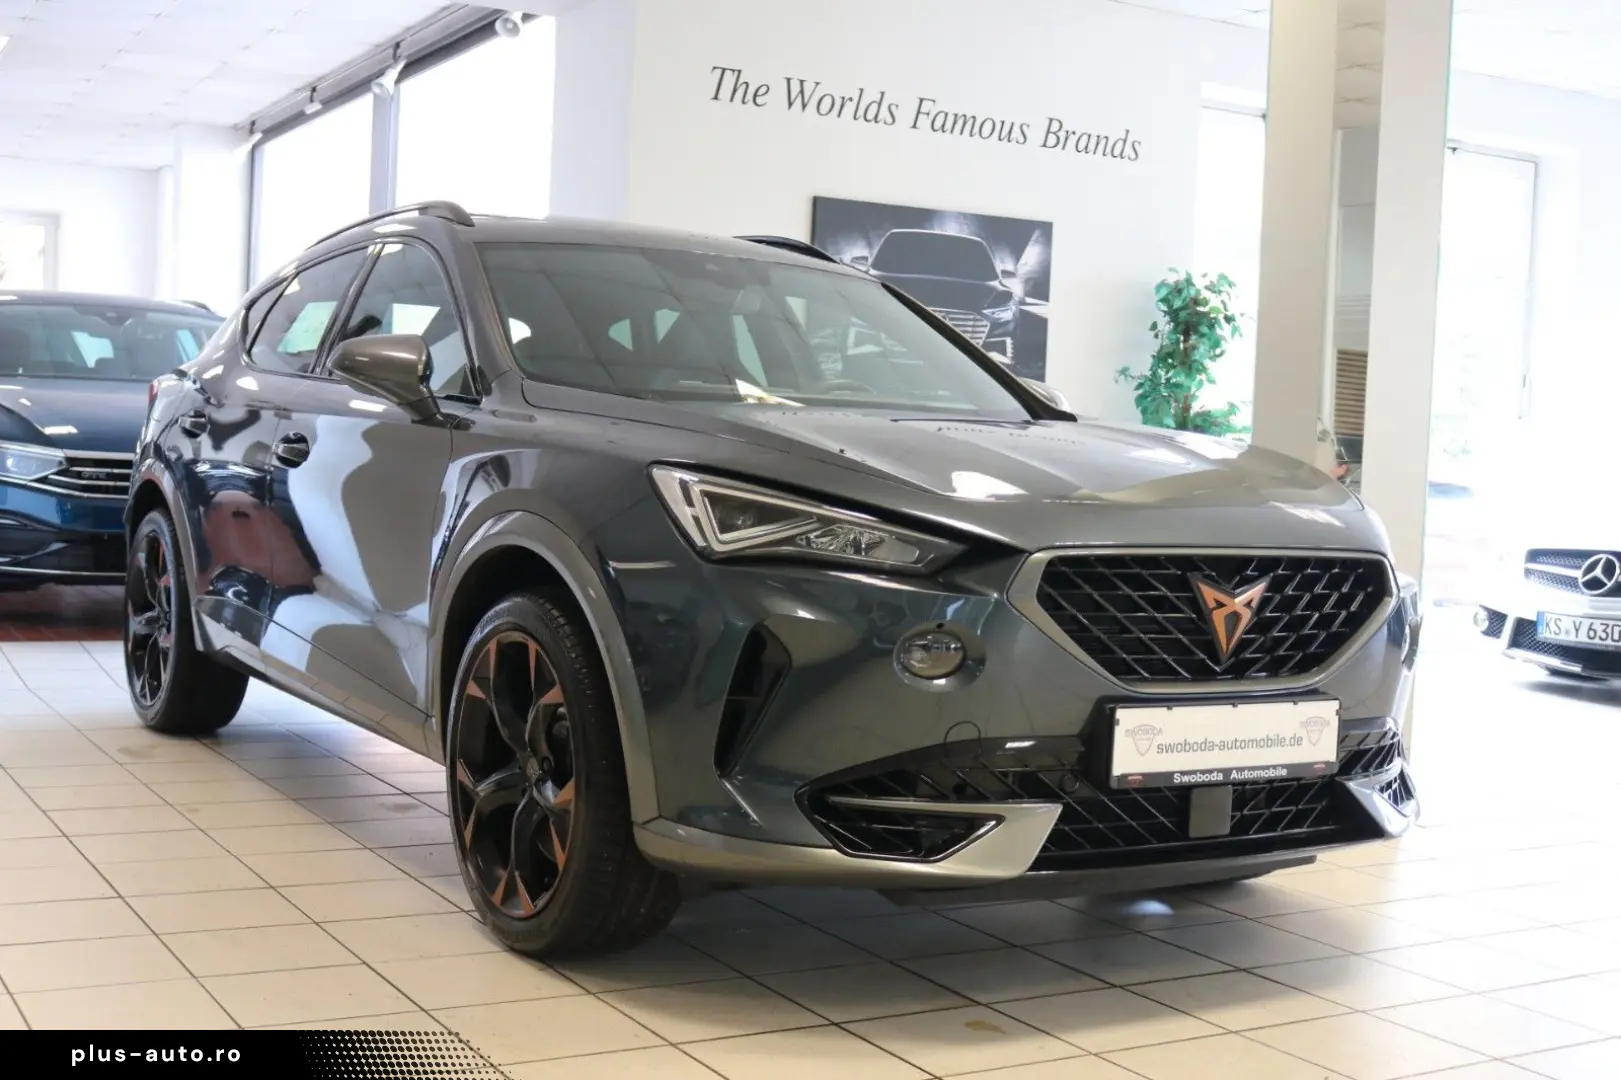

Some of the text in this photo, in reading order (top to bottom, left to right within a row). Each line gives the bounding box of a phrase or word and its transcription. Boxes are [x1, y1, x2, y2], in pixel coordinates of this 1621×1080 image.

[709, 66, 1142, 162] The Worlds Famous Brands
[1587, 621, 1621, 643] 630
[1156, 733, 1303, 754] swoboda-automobile.de
[1173, 766, 1288, 784] Swoboda Automobile
